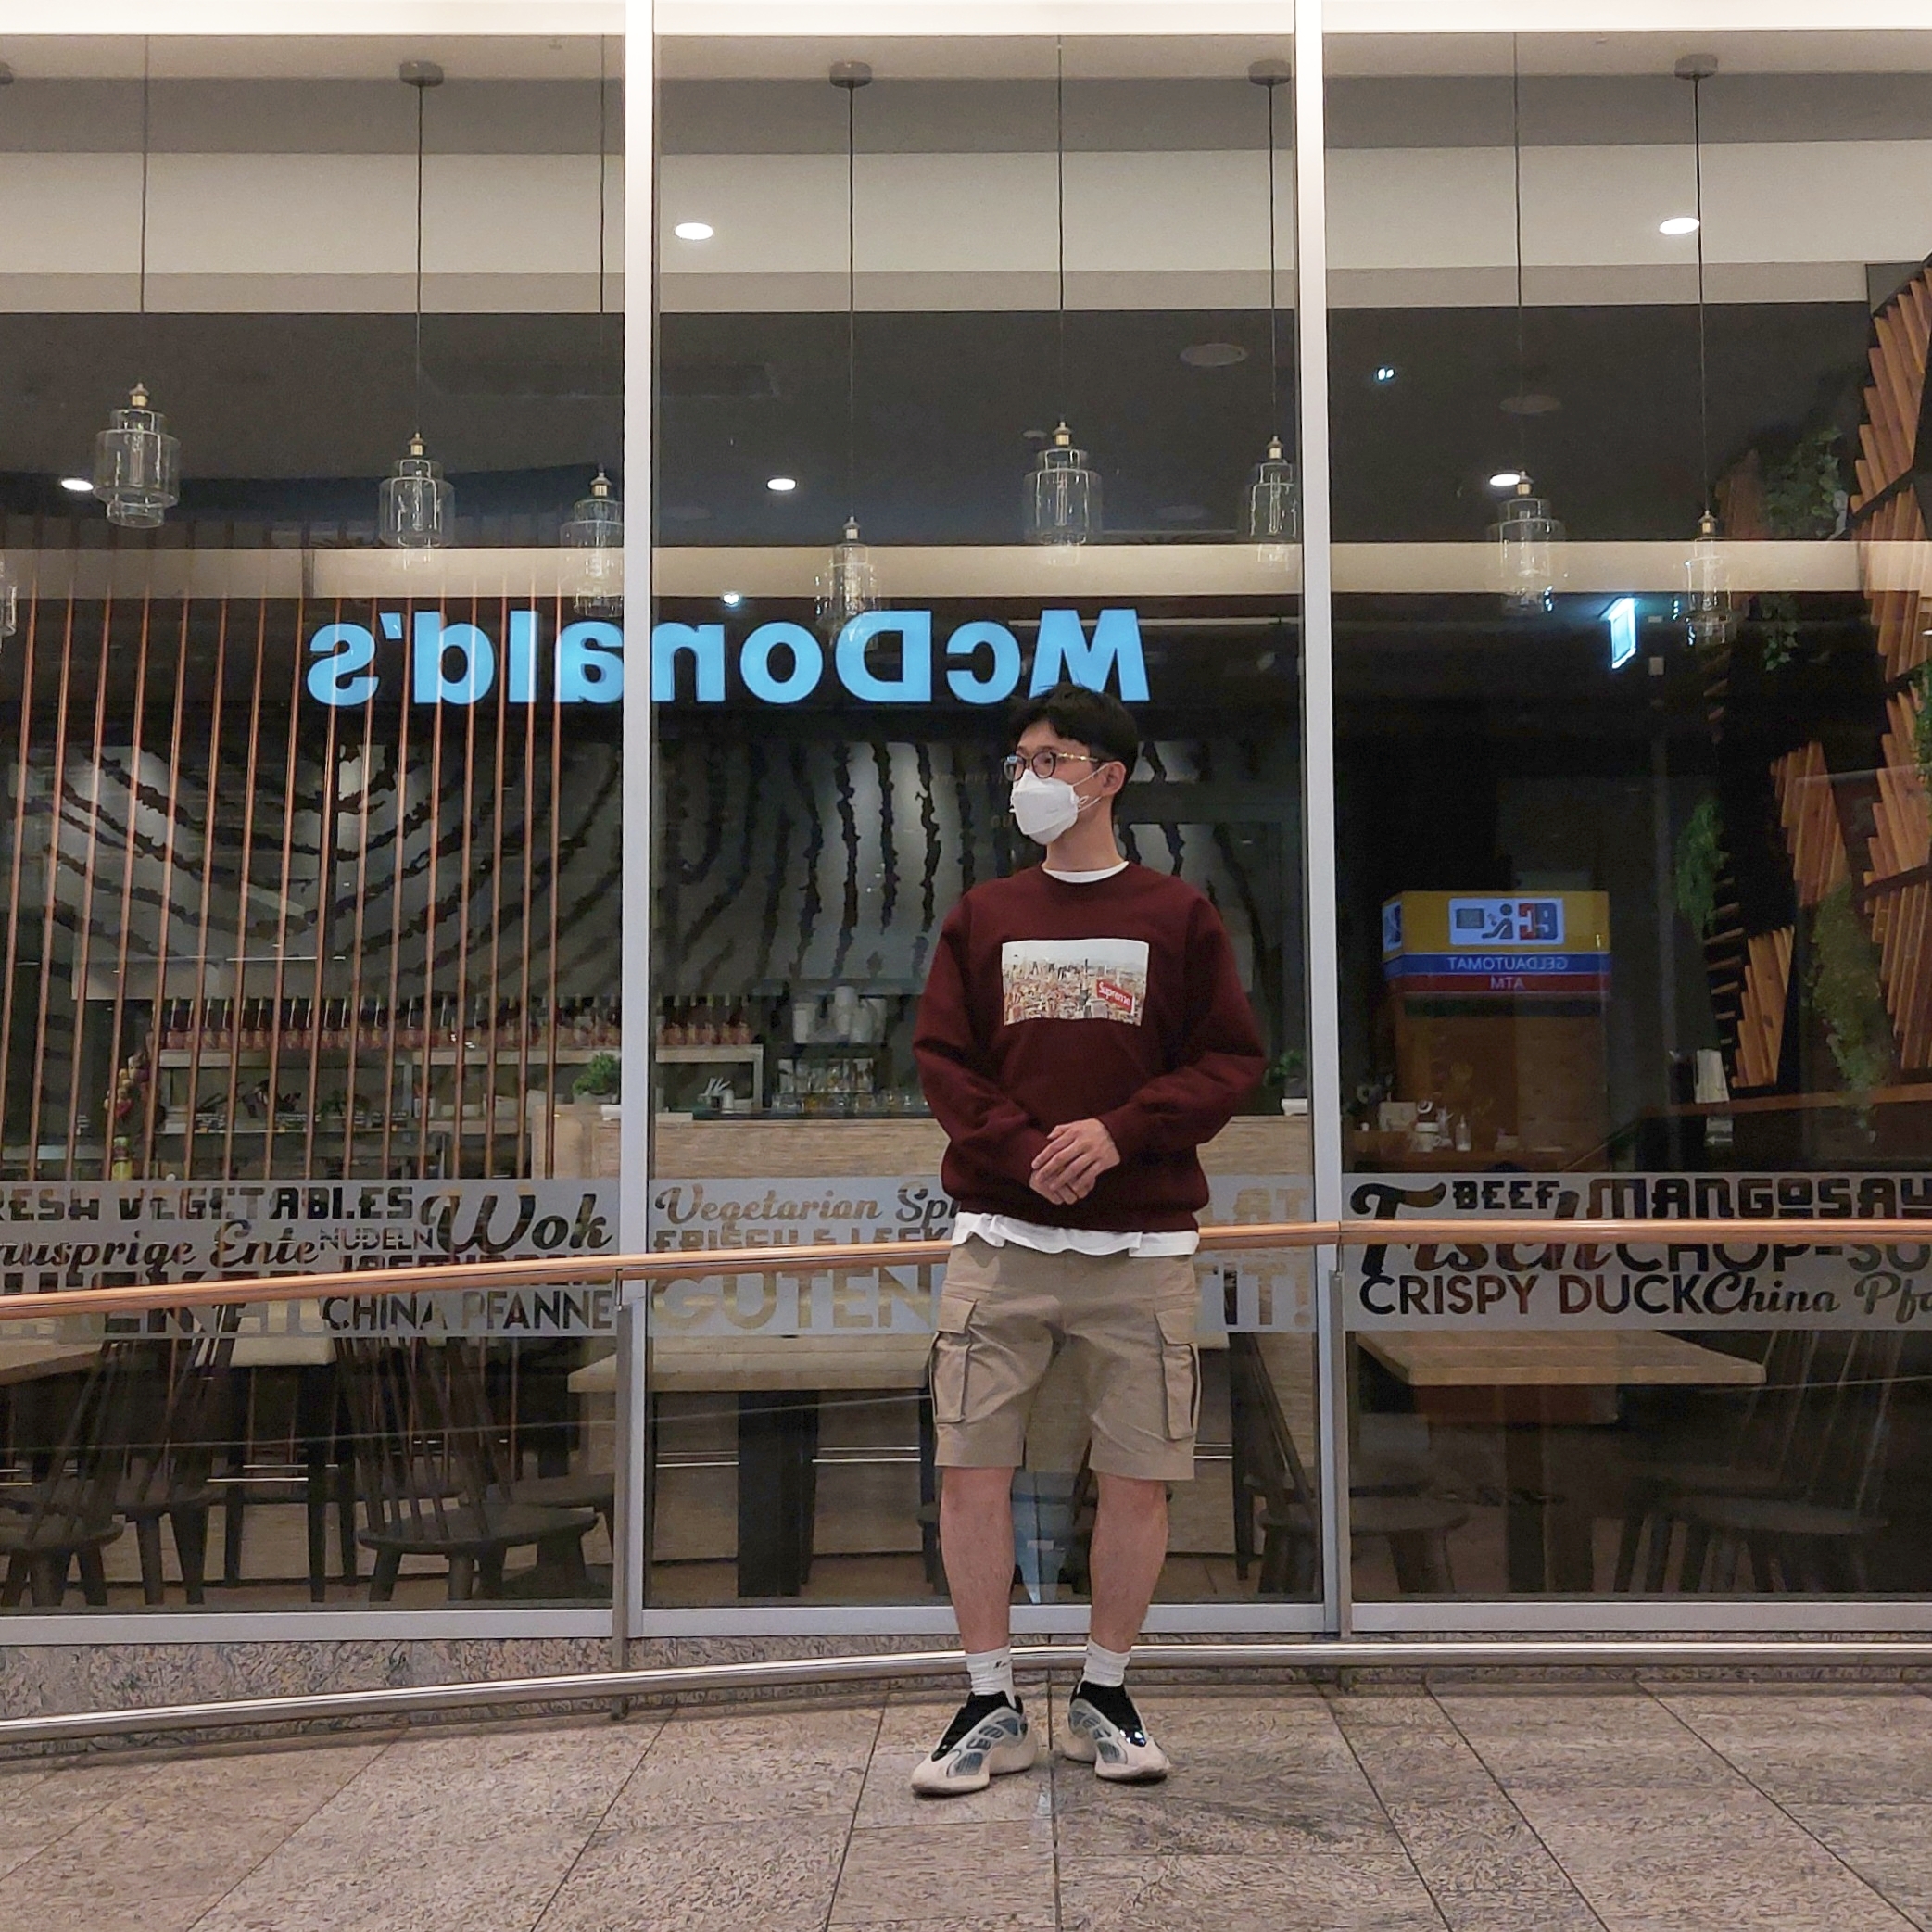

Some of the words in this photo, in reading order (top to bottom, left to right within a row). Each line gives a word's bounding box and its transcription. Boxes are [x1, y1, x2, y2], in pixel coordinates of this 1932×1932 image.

[1098, 981, 1131, 1005] Supreme
[0, 1187, 100, 1221] ESH
[119, 1186, 413, 1220] VEGETABLES
[654, 1183, 882, 1231] Vegetarian
[1452, 1181, 1560, 1210] BEEF
[319, 1227, 433, 1251] NUDELN
[421, 1183, 613, 1255] Wok
[209, 1219, 320, 1269] Ente
[321, 1292, 448, 1331] CHINA
[462, 1290, 612, 1330] PFANNE
[651, 1264, 932, 1330] GUTEN
[1359, 1274, 1540, 1315] CRISPY
[1559, 1274, 1704, 1315] DUCK
[1703, 1270, 1841, 1315] China
